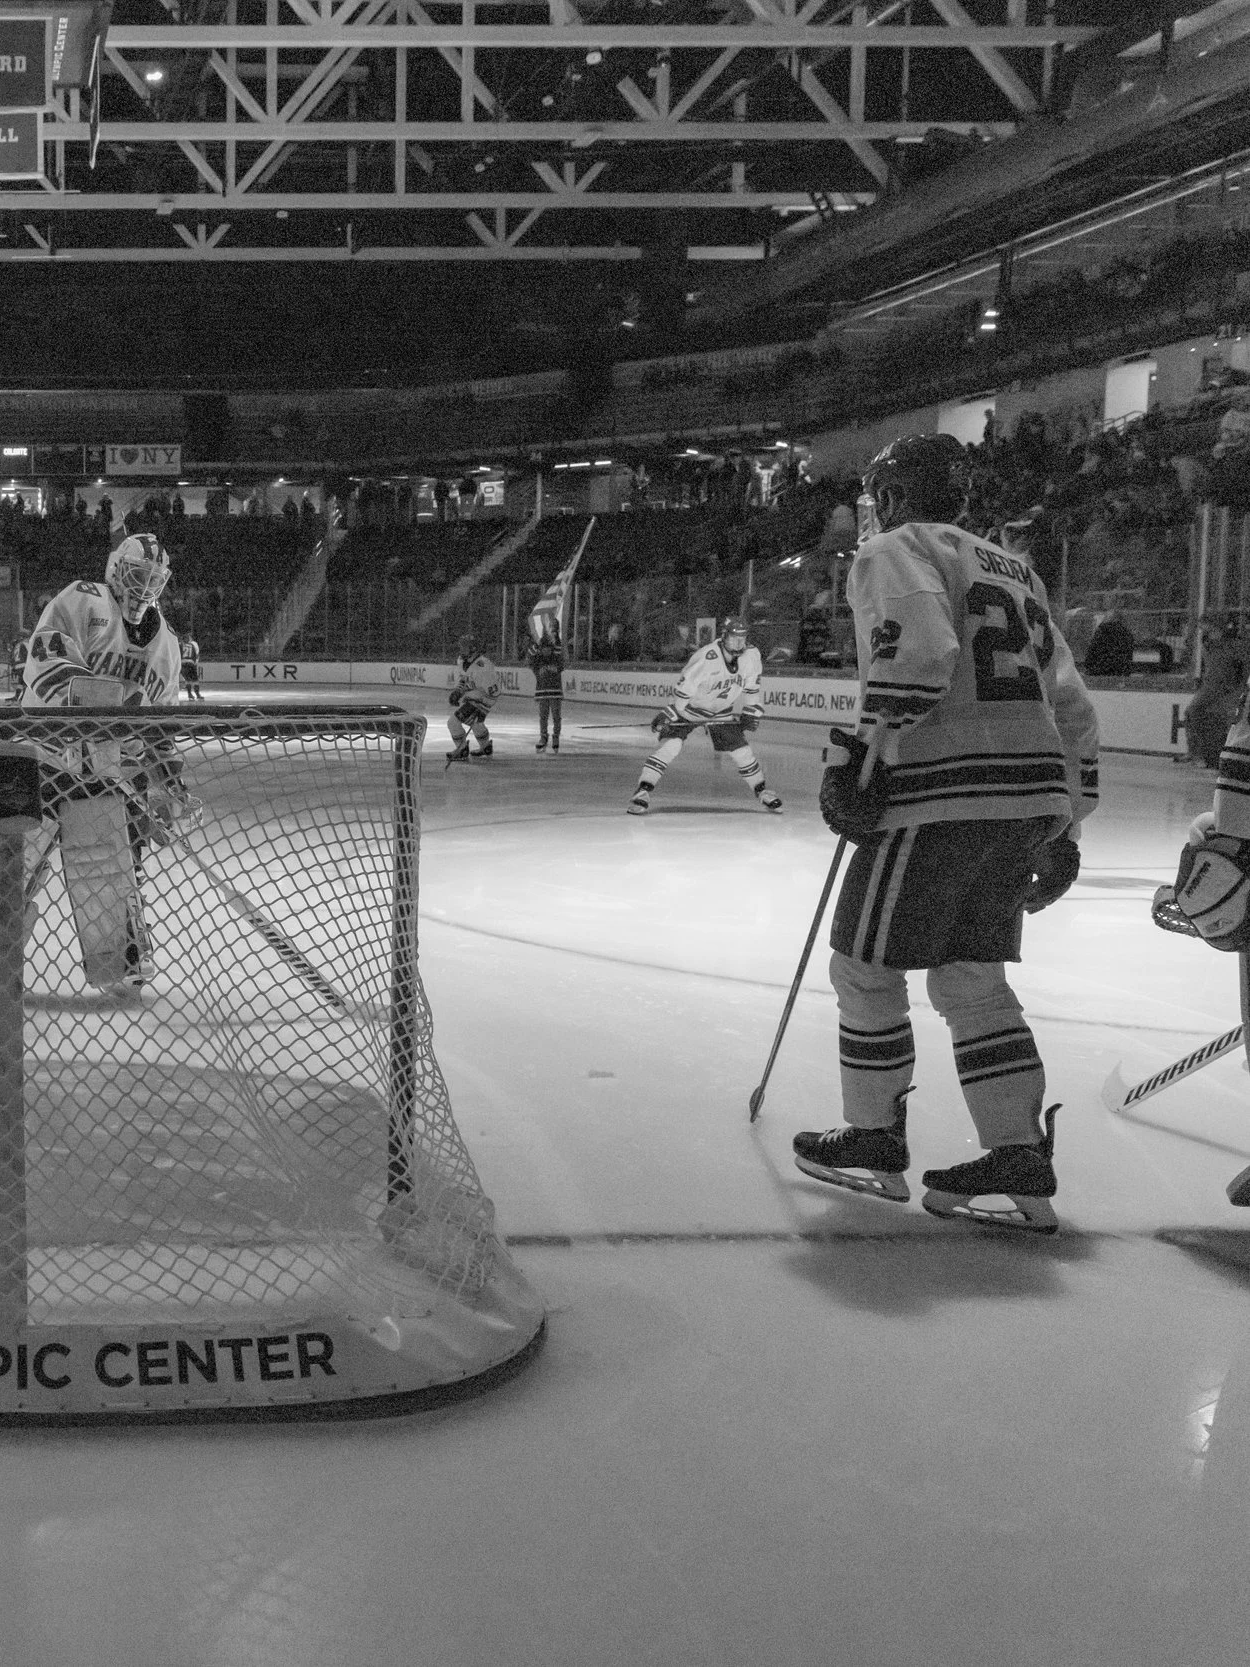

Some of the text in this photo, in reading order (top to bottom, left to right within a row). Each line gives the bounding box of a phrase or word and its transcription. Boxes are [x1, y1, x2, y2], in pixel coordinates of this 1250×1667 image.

[51, 17, 69, 81] LYMPIC CENTER
[109, 447, 179, 465] I NY
[31, 632, 68, 663] 44
[86, 650, 165, 704] HARVARD
[230, 664, 298, 681] TIXR
[390, 666, 427, 684] QUINNIPIAC
[593, 681, 609, 694] ECAC
[610, 681, 635, 697] HOCKEY
[636, 683, 657, 697] MEN'S
[658, 685, 675, 698] CHA
[763, 691, 856, 713] LAKE PLACID, NEW
[95, 1331, 338, 1390] CENTER
